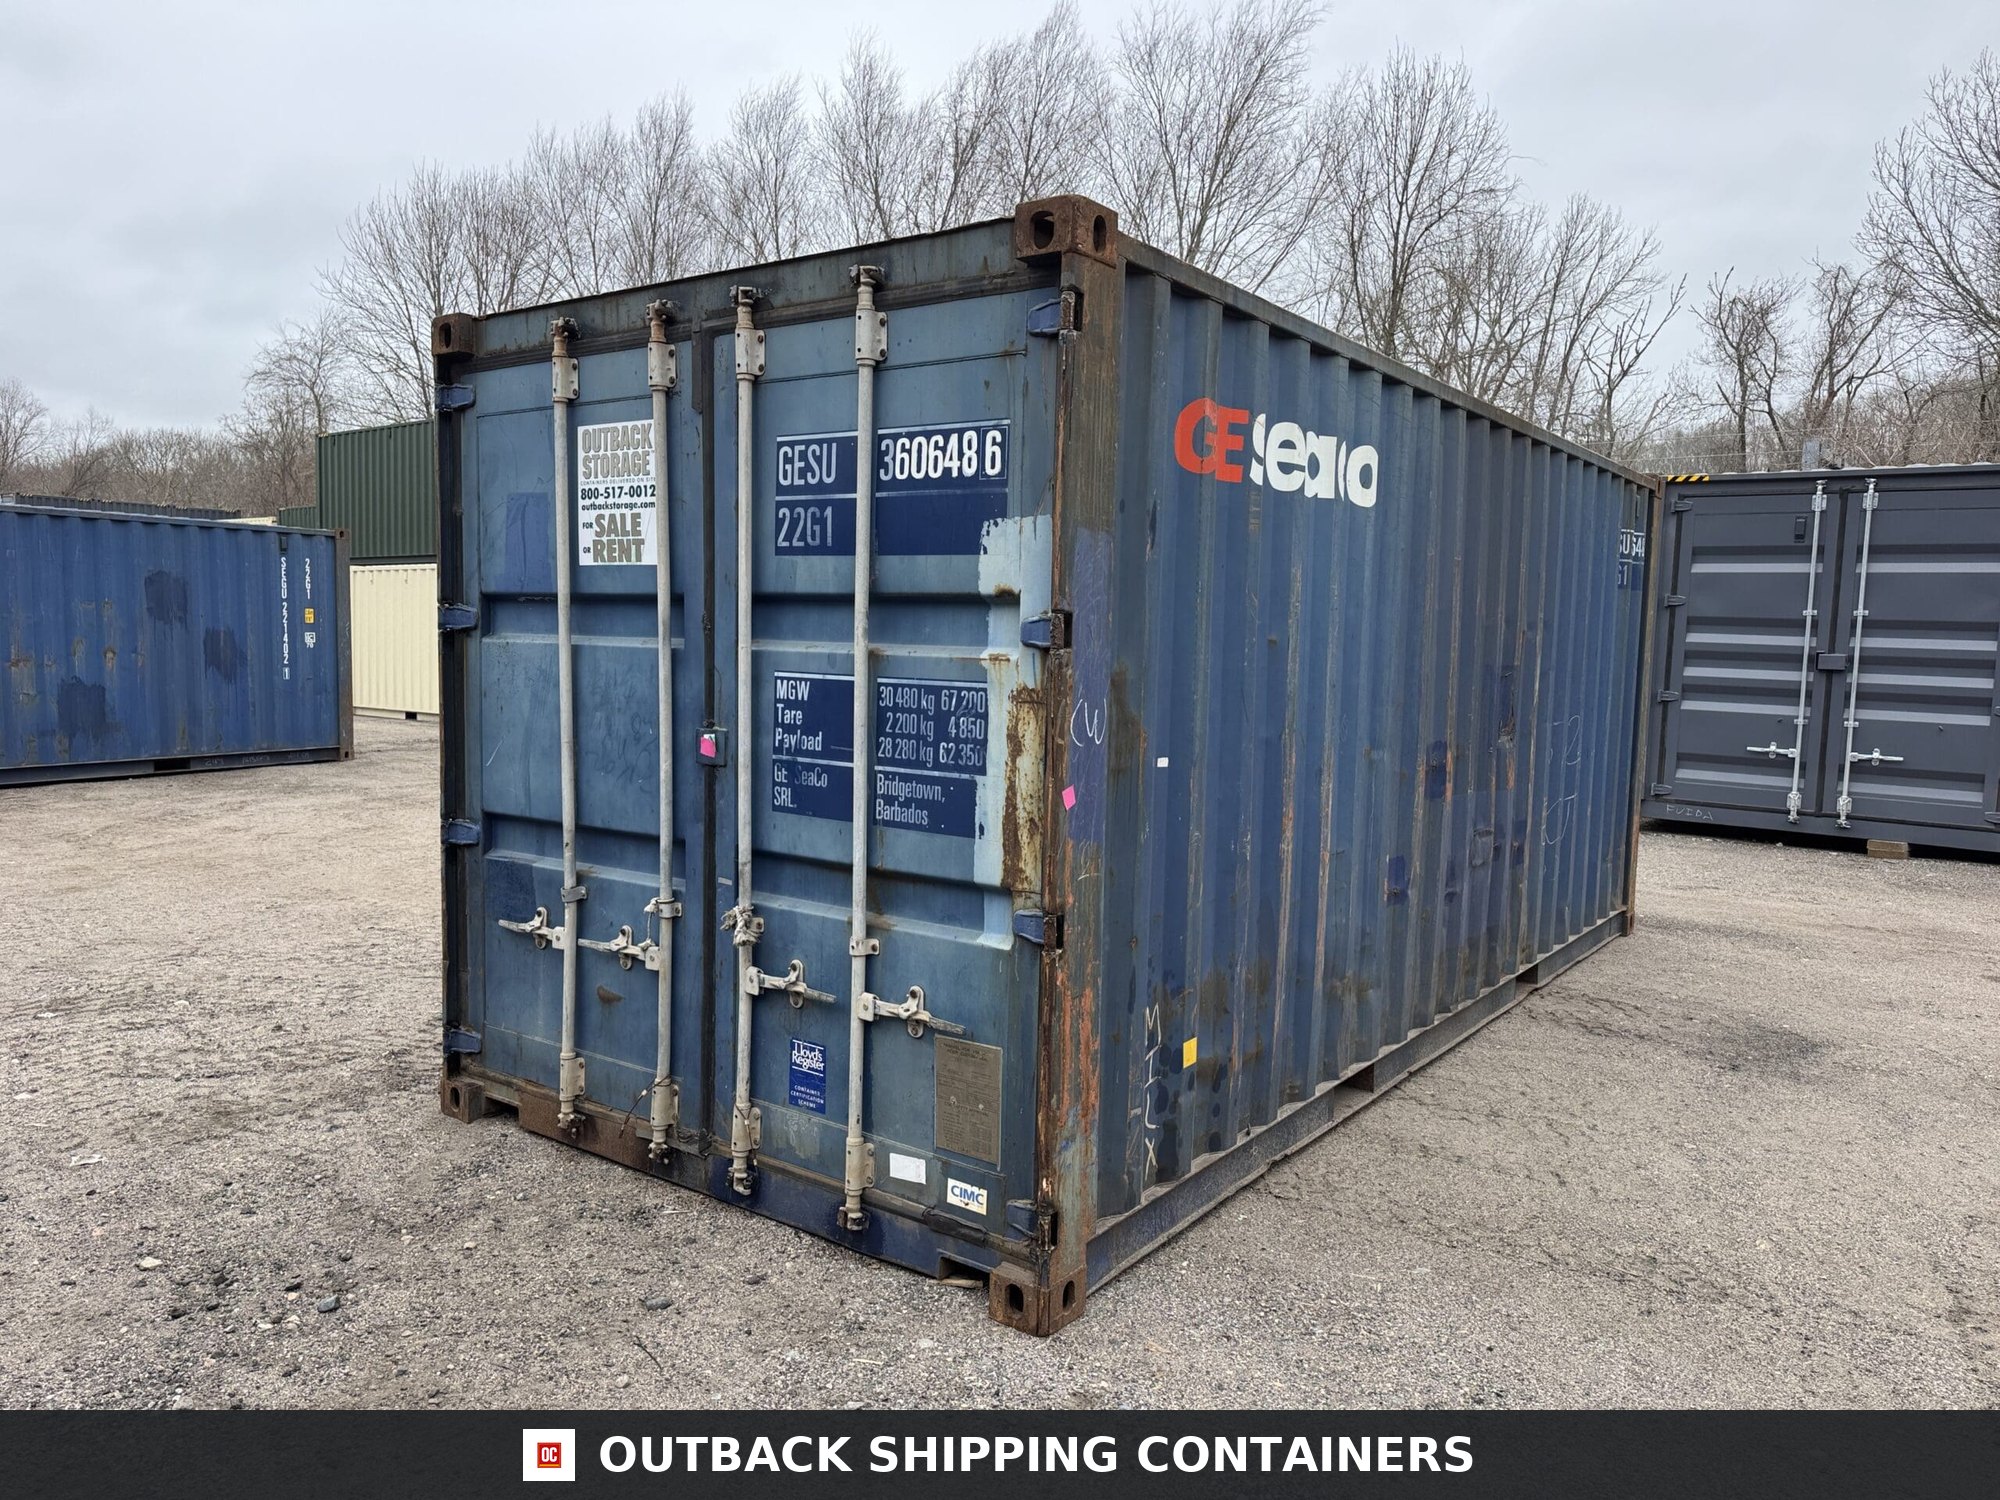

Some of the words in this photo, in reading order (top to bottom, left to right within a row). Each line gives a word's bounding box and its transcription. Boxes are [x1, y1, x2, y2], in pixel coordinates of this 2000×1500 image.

[581, 423, 653, 454] OUTBACK
[582, 450, 650, 480] STORAGE
[778, 442, 837, 486] GESU
[879, 430, 978, 481] 360648
[580, 484, 656, 500] 800-517-0012
[581, 501, 656, 511] outbackstorage.com
[582, 521, 594, 530] FOR
[594, 512, 642, 538] SALE
[777, 506, 833, 547] 22G1
[582, 546, 591, 554] OR
[592, 538, 645, 563] RENT
[776, 679, 810, 701] MGW
[921, 688, 935, 716] kg
[776, 703, 803, 725] Tare
[920, 714, 934, 742] kg
[775, 727, 823, 753] Payload
[920, 740, 934, 768] kg
[794, 765, 828, 788] SeaCo
[876, 773, 946, 803] Bridgetown,
[875, 798, 928, 826] Barbados
[791, 1050, 825, 1071] Register
[794, 1042, 823, 1062] Lloyd's
[798, 1099, 816, 1109] SCHEME
[950, 1185, 984, 1206] CIMC
